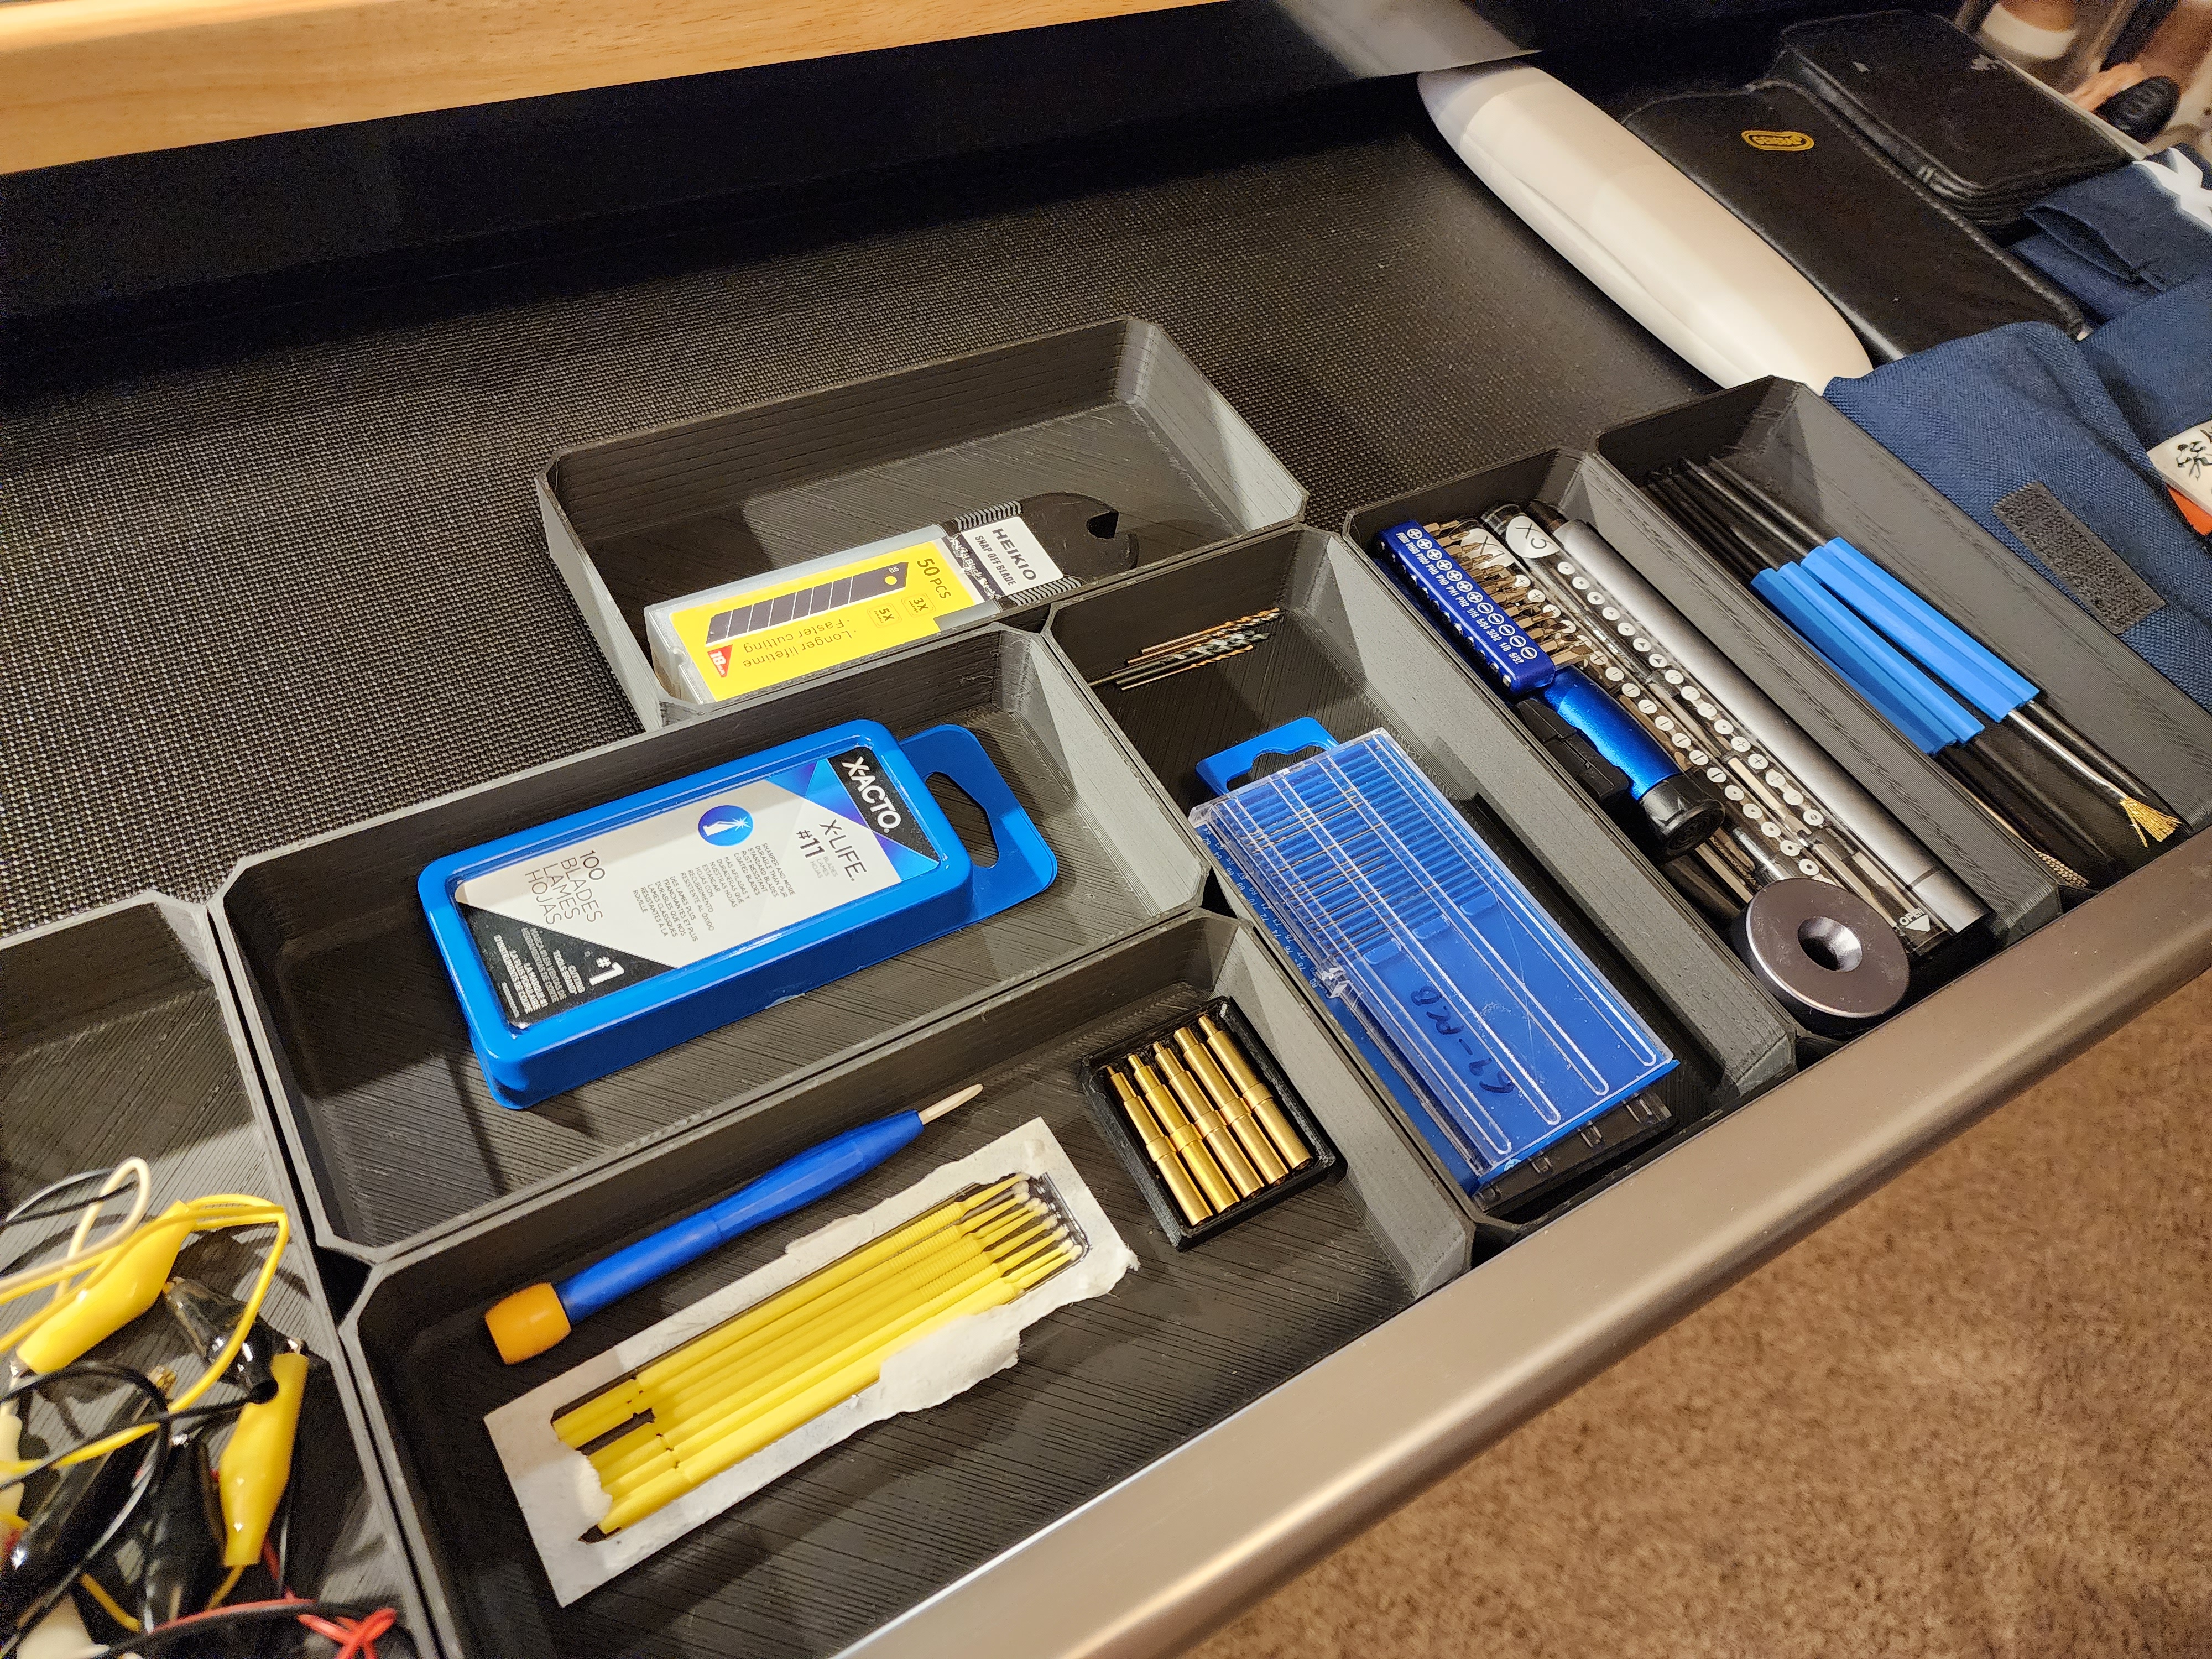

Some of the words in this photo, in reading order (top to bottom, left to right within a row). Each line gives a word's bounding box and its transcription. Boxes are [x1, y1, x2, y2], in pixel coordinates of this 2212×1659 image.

[974, 535, 993, 552] SNAP
[987, 552, 1002, 565] OFF
[995, 565, 1016, 586] BLADE
[991, 528, 1038, 581] HEIKIO
[915, 557, 941, 576] 50
[929, 578, 952, 599] PCS
[878, 608, 894, 621] 5X
[912, 597, 928, 611] 3X
[1425, 564, 1439, 575] PH0
[1435, 574, 1450, 585] PH0
[1446, 585, 1460, 596] PH1
[1455, 596, 1470, 607] PH2
[1467, 608, 1480, 618] 1/16
[1476, 617, 1491, 629] 5/64
[1486, 628, 1503, 641] 3/32
[1499, 641, 1512, 651] 1/8
[1508, 651, 1525, 664] 5/32
[796, 619, 844, 638] Faster
[743, 633, 794, 653] cutting
[800, 632, 852, 650] Longer
[743, 646, 798, 667] lifetime
[795, 828, 825, 858] #11
[579, 849, 608, 882] 100
[733, 852, 749, 874] COATED
[745, 874, 761, 896] BLADES
[740, 850, 752, 864] RUST
[748, 864, 768, 893] RESISTANT
[747, 848, 767, 875] STANDARD
[763, 875, 779, 897] BLADES
[754, 845, 771, 869] DURABLE
[769, 870, 781, 885] THAN
[777, 885, 788, 898] OUR
[761, 842, 779, 867] SHARPER
[775, 867, 786, 879] AND
[782, 879, 795, 895] MORE
[809, 860, 824, 879] HOJAS
[816, 858, 831, 876] LAMES
[822, 855, 838, 877] BLADES
[1225, 867, 1234, 875] 66
[1237, 871, 1246, 879] 67
[542, 863, 582, 920] LAMES
[560, 857, 604, 923] BLADES
[680, 872, 700, 904] RESISTENTE
[697, 904, 705, 912] AL
[687, 869, 714, 913] RECUBRIMIENTO
[694, 867, 707, 884] HOJAS
[704, 885, 714, 898] CON
[709, 862, 727, 889] NUESTRAS
[724, 889, 737, 908] HOJAS
[716, 859, 737, 891] DURADERAS
[734, 891, 744, 904] QUE
[730, 868, 748, 895] AFILADAS
[1236, 881, 1245, 890] 68
[1249, 886, 1258, 895] 69
[524, 869, 564, 926] HOJAS
[632, 889, 648, 913] ROUILLE
[655, 881, 673, 910] DURABLES
[669, 910, 680, 923] QUE
[676, 923, 686, 936] NOS
[669, 875, 679, 886] DES
[675, 887, 688, 906] LAMES
[685, 906, 696, 920] PLUS
[1248, 897, 1257, 906] 70
[647, 884, 660, 902] LAMES
[656, 902, 677, 937] CLASSIQUES
[662, 878, 686, 919] TRANCHANTES
[687, 927, 698, 942] PLUS
[1259, 913, 1269, 921] 72
[1272, 917, 1281, 926] 73
[1899, 907, 1924, 924] OPEN
[529, 928, 545, 951] MARCA
[660, 928, 669, 937] LA
[1284, 933, 1293, 942] 75
[493, 934, 520, 982] D'INSTRUMENTS
[509, 949, 519, 960] LA
[520, 926, 546, 972] HERRAMIENTAS
[551, 950, 567, 971] TOOLS
[1284, 945, 1293, 953] 76
[1297, 950, 1307, 959] 77
[513, 958, 525, 975] PLUS
[523, 962, 533, 972] LA
[541, 956, 552, 967] EN
[588, 954, 625, 985] #1
[1296, 962, 1306, 971] 78
[513, 981, 524, 992] DE
[527, 971, 545, 999] MARQUE
[540, 972, 550, 982] DE
[546, 966, 563, 990] VENTAS
[567, 964, 586, 993] CUTTING
[1308, 978, 1320, 988] 80
[517, 990, 533, 1013] COUPE
[520, 974, 540, 1010] POPULAIRE
[544, 980, 559, 1003] CORTE
[556, 989, 567, 1000] DE
